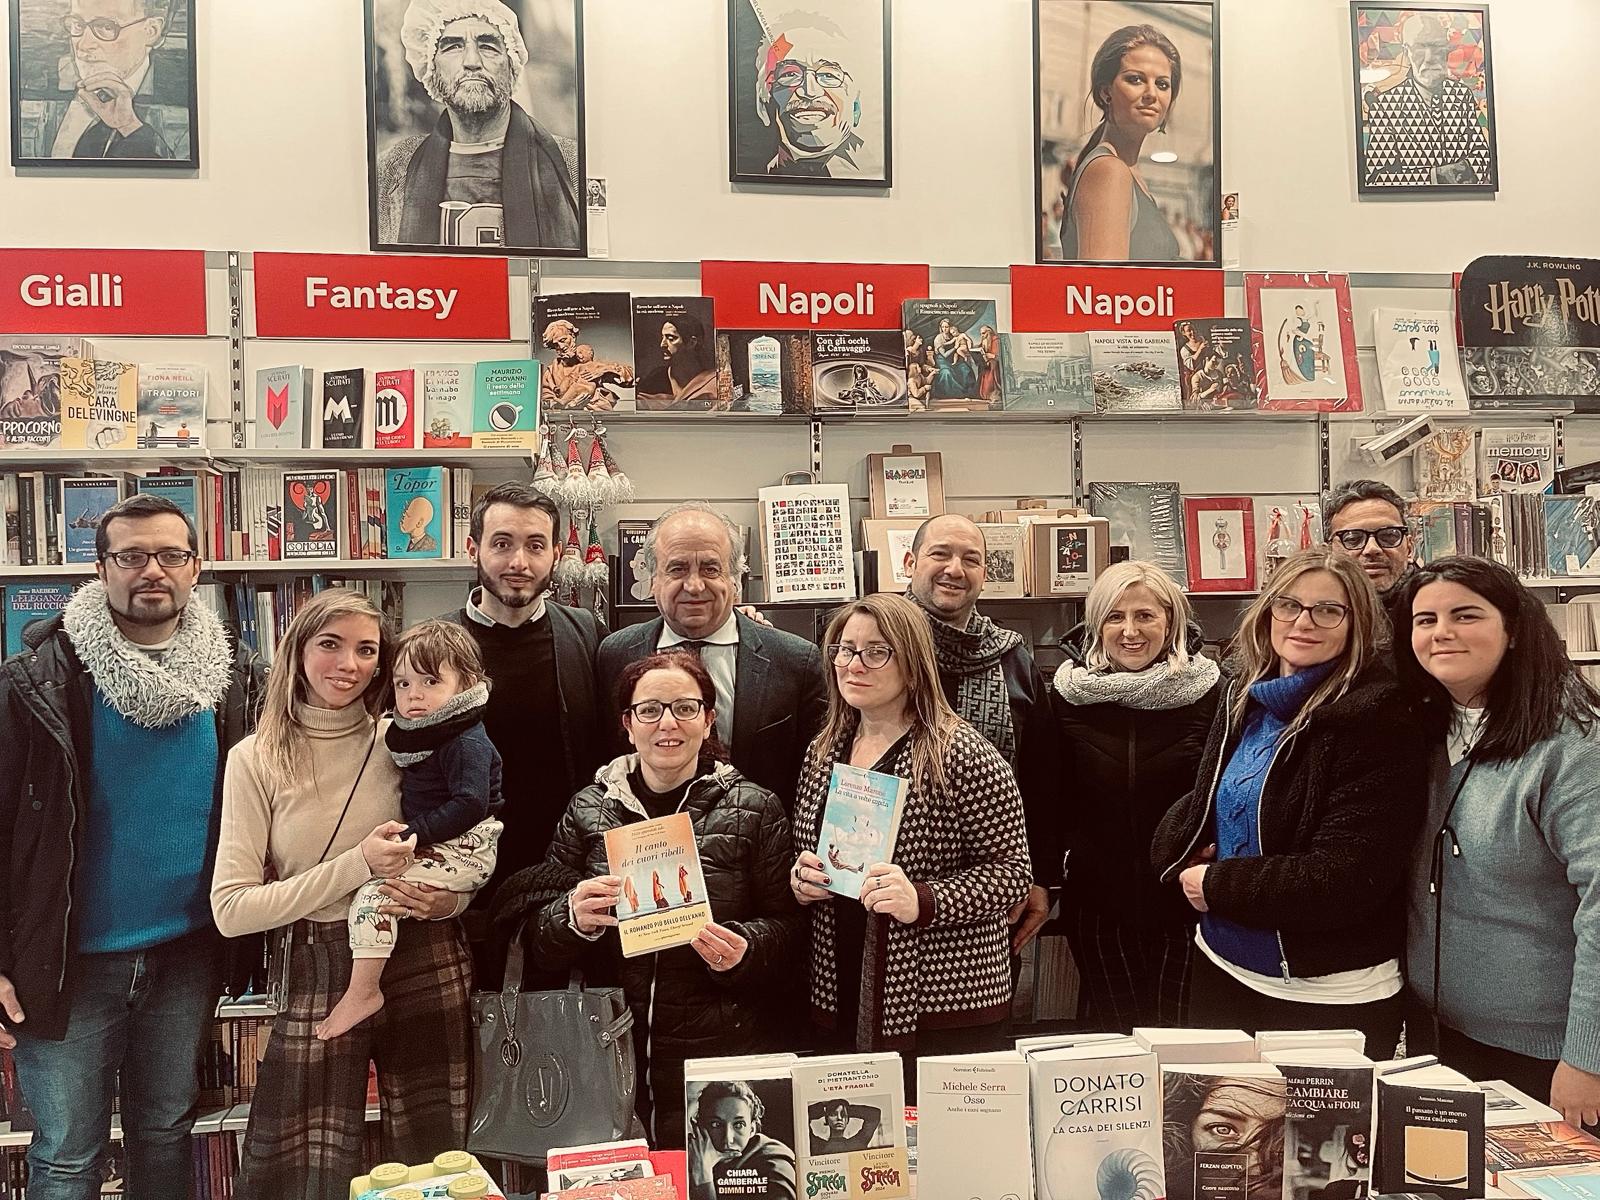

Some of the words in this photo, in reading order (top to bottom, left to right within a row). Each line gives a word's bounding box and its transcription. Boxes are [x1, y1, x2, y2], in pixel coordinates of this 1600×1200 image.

[1543, 262, 1581, 270] ROWLING
[20, 273, 123, 307] Gialli
[305, 276, 457, 320] Fantasy
[759, 282, 874, 324] Napoli
[1066, 285, 1174, 324] Napoli
[1484, 281, 1554, 334] Harry
[838, 337, 846, 347] gli
[827, 345, 871, 353] Caravaggio
[325, 378, 351, 386] SCURATI
[148, 389, 200, 397] TRADITORI
[88, 395, 116, 409] CARA
[68, 407, 136, 423] DELEVINGNE
[324, 395, 354, 423] M
[0, 420, 61, 435] PPOCORNO
[1487, 445, 1551, 461] memory
[885, 469, 925, 480] NAPOLI
[394, 471, 437, 492] Topor
[11, 594, 68, 602] L'ELEGANZA
[34, 602, 65, 610] RICCIO
[842, 791, 853, 799] vita
[858, 795, 871, 803] volte
[635, 844, 642, 854] Il
[644, 840, 667, 850] canto
[622, 858, 634, 868] dei
[636, 854, 658, 864] cuori
[661, 845, 685, 859] ribelli
[629, 923, 653, 935] ROMANZO
[663, 917, 679, 926] BELLO
[679, 911, 705, 923] DELL'ANNO
[828, 1074, 879, 1082] PIETRANTONIO
[1054, 1073, 1145, 1093] DONATO
[942, 1081, 977, 1091] Michele
[980, 1082, 1006, 1091] Serra
[1286, 1087, 1349, 1098] CAMBIARE
[964, 1095, 985, 1104] Osso
[1335, 1101, 1360, 1109] FIORI
[1060, 1096, 1142, 1116] CARRISI
[1053, 1126, 1064, 1134] LA
[1069, 1125, 1094, 1133] CASA
[1097, 1123, 1112, 1131] DEI
[1116, 1121, 1151, 1131] SILENZI
[439, 1152, 466, 1165] LEGO
[809, 1158, 841, 1166] Vincitore
[863, 1152, 895, 1160] Vincitore
[376, 1166, 405, 1177] LEGO
[726, 1169, 758, 1177] CHIARA
[454, 1177, 482, 1189] LEGO
[718, 1177, 768, 1186] GAMBERALE
[719, 1186, 745, 1194] DIMMI
